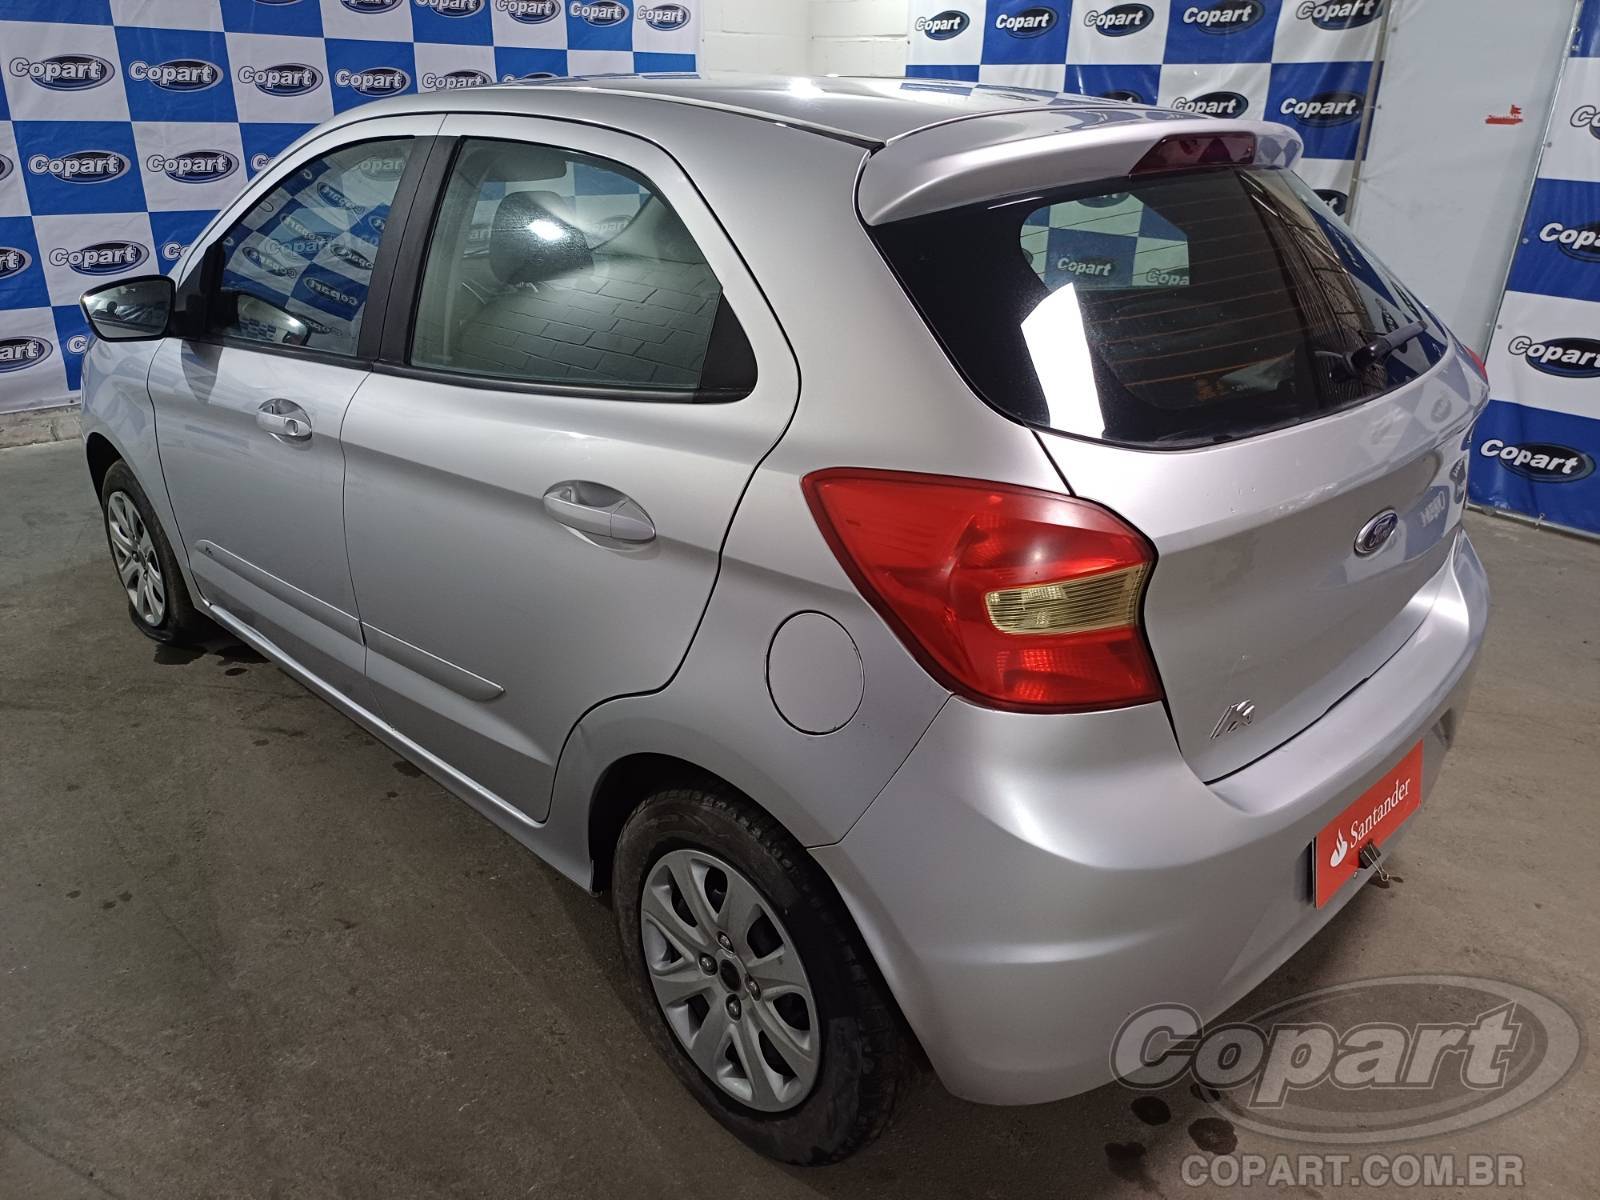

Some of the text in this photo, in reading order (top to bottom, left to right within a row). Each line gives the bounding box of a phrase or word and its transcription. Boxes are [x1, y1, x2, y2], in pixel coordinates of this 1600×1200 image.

[496, 0, 553, 17] Copart
[569, 2, 623, 20] Copart
[636, 4, 685, 24] Copart
[1084, 9, 1145, 29] Copart
[1183, 4, 1253, 27] Copart
[1296, 0, 1375, 22] Copart
[915, 16, 961, 34] Copart
[995, 12, 1050, 35] Copart
[9, 56, 101, 83] Copart
[129, 60, 213, 87] Copart
[238, 65, 314, 90] Copart
[335, 68, 403, 92] Copart
[422, 73, 484, 89] Copart
[1171, 96, 1238, 115] Copart
[1280, 97, 1357, 119] Copart
[28, 153, 119, 179] Copart
[147, 153, 228, 177] Copart
[50, 244, 137, 269] Copart
[1056, 256, 1113, 277] Copart
[1146, 268, 1190, 286] Copa
[1480, 438, 1579, 475] Copart
[1350, 777, 1411, 849] Santander
